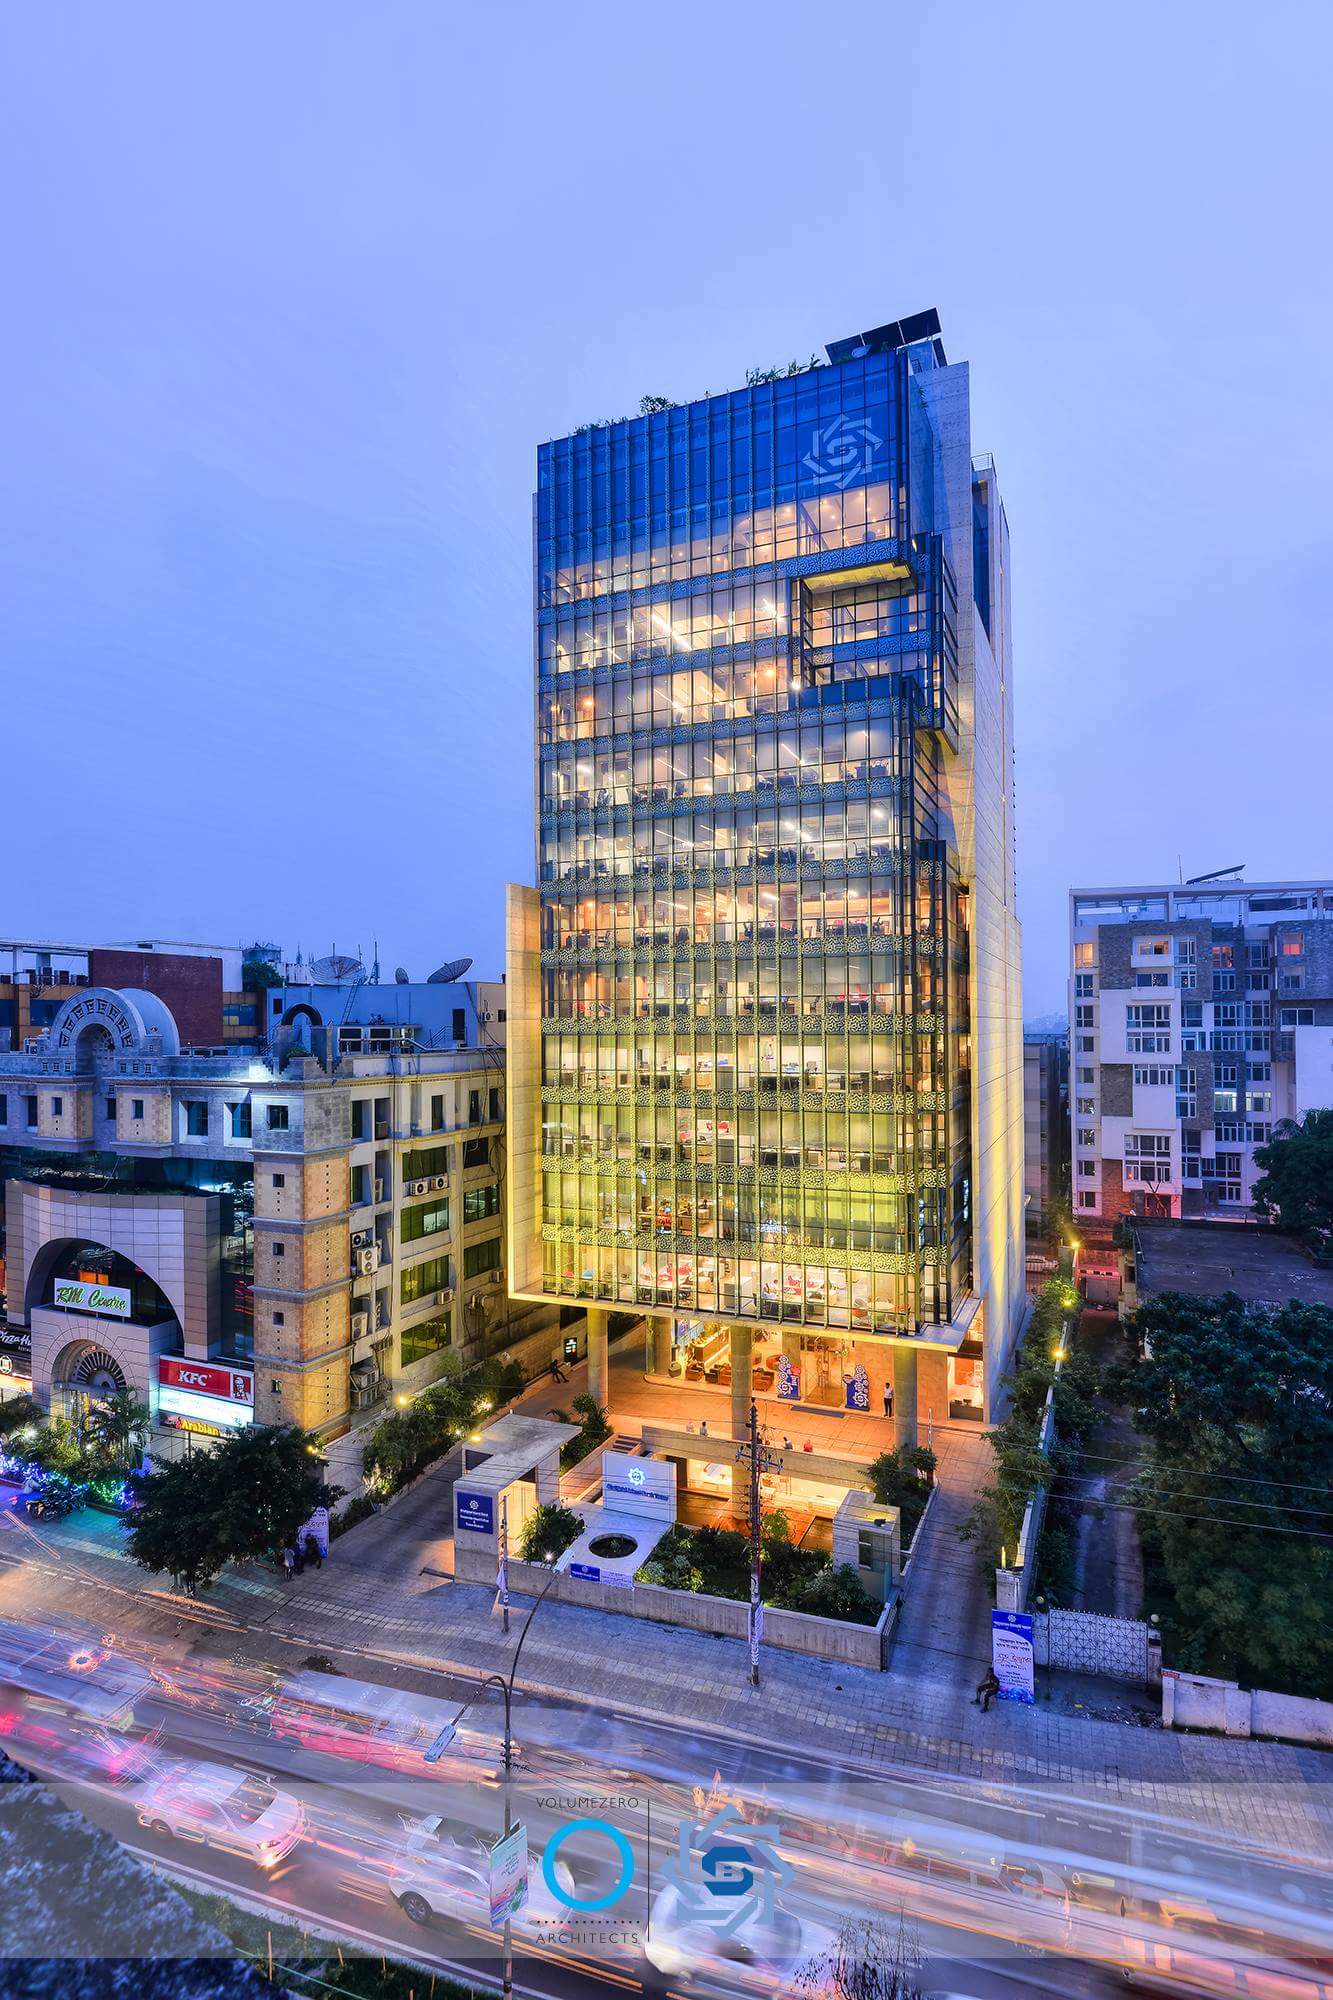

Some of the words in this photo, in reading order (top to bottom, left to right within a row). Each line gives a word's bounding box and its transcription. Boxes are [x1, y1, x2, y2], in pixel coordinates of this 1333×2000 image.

[56, 1286, 84, 1303] RM
[20, 1334, 32, 1346] Hu
[178, 1370, 208, 1387] KFC
[181, 1419, 219, 1437] Arabian
